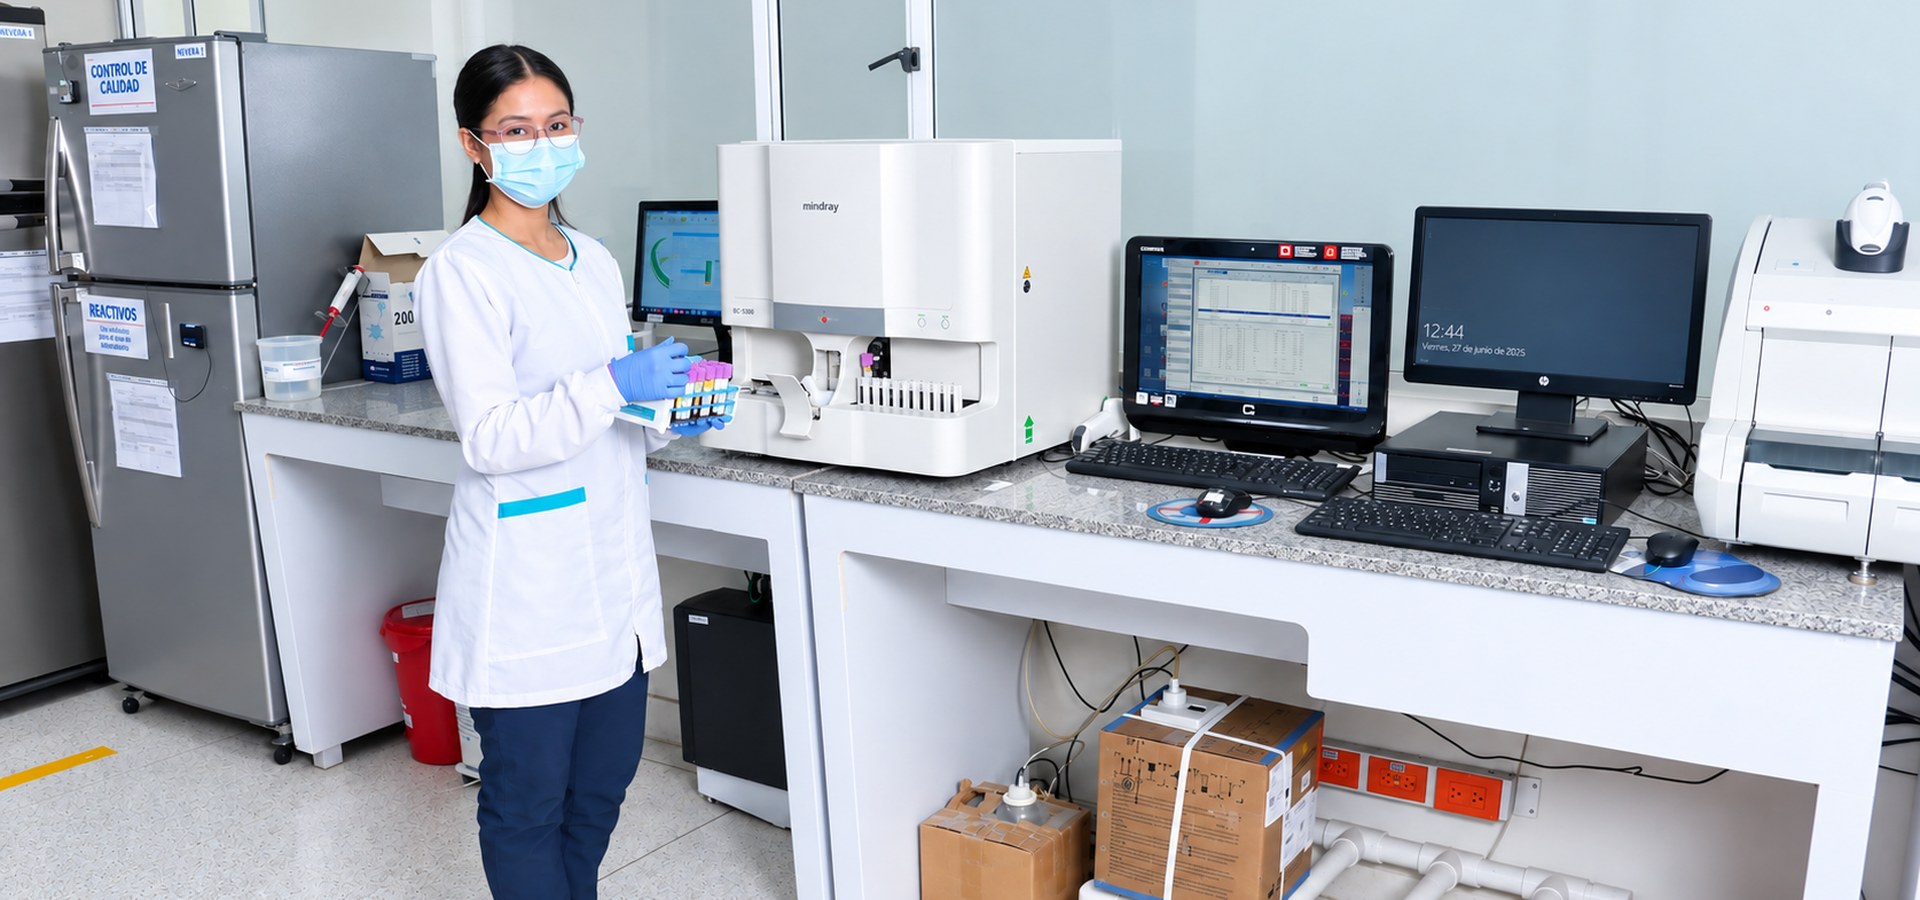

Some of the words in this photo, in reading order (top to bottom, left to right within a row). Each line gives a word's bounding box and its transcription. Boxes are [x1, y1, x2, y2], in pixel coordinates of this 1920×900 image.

[177, 47, 200, 57] NEVERA
[91, 62, 133, 78] CONTROL
[135, 60, 147, 75] DE
[100, 79, 139, 94] CALIDAD
[803, 201, 839, 213] mindray
[89, 303, 137, 321] REACTIVOS
[394, 310, 414, 325] 200
[1423, 323, 1464, 339] 12:44
[1451, 344, 1461, 352] 27
[1462, 344, 1472, 353] de
[1473, 346, 1493, 355] junio
[1494, 346, 1505, 355] de
[1506, 347, 1526, 357] 2025
